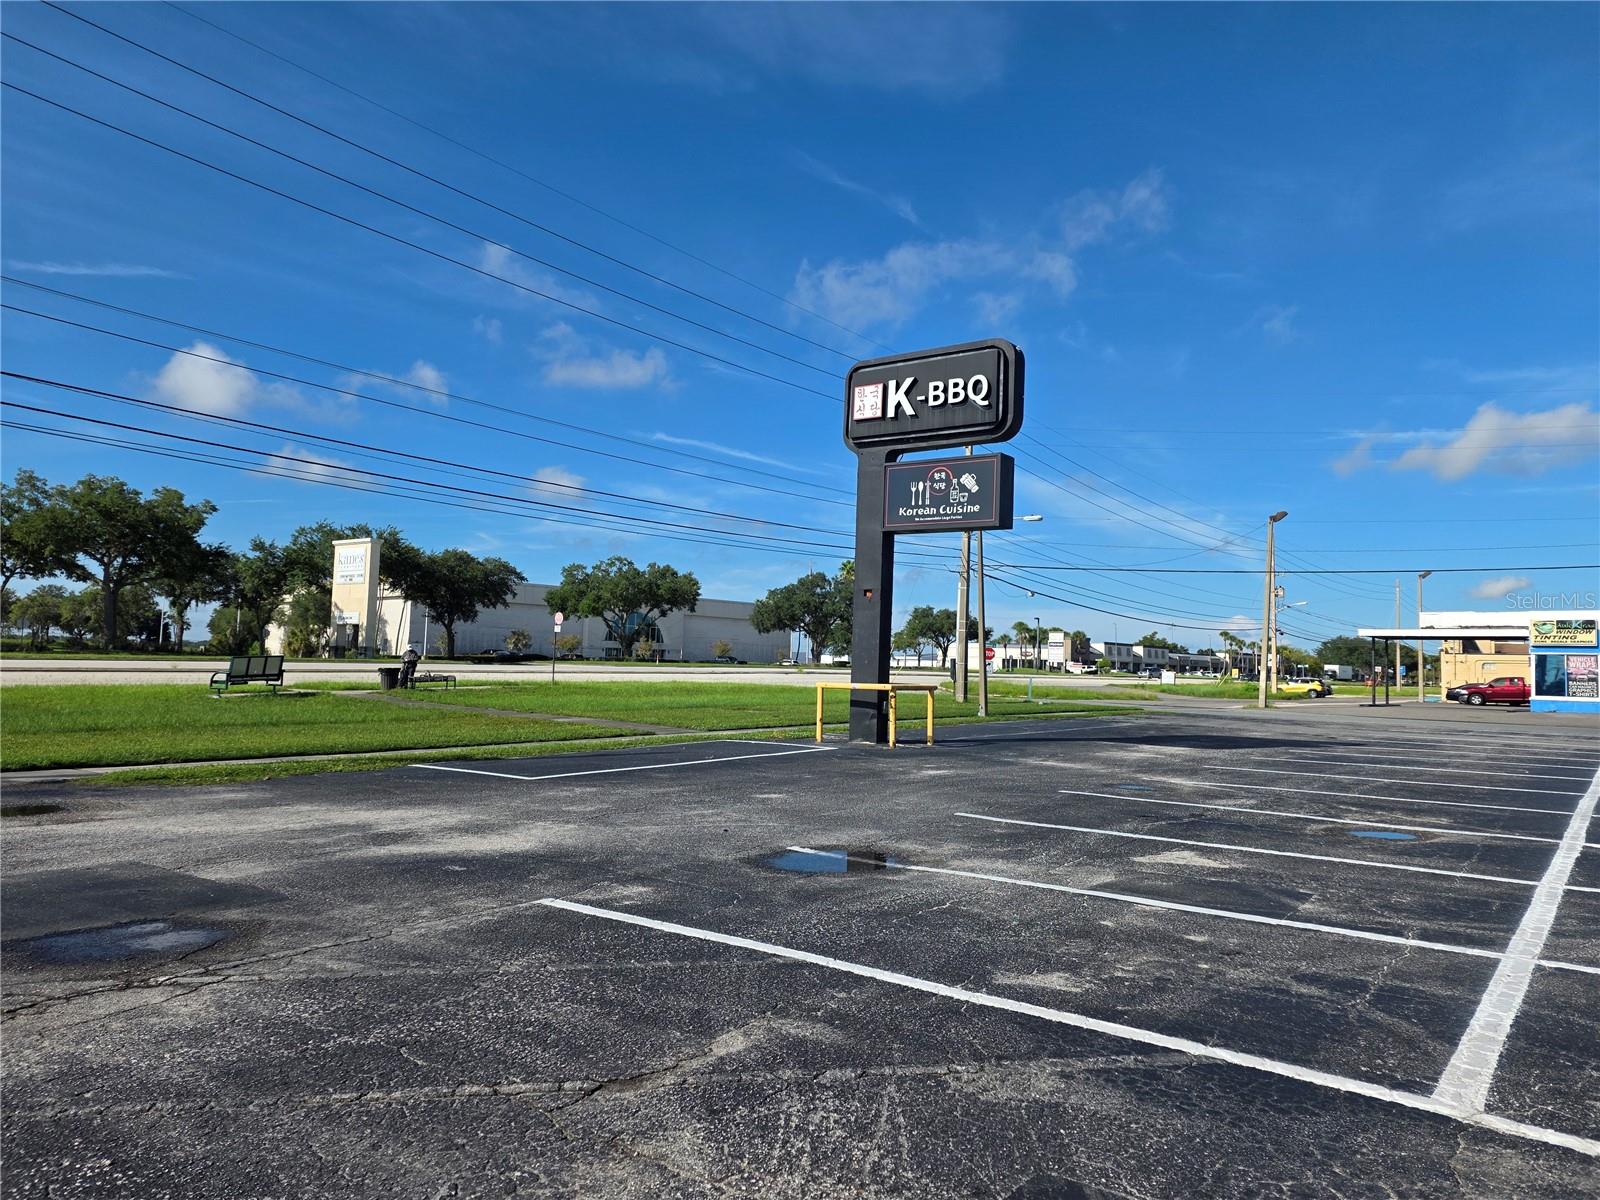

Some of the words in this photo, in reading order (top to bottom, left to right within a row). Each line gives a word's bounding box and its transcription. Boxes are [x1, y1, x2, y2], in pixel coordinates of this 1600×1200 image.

[887, 374, 990, 418] K-BBQ
[899, 507, 936, 516] Korean
[939, 503, 980, 514] Cuisine
